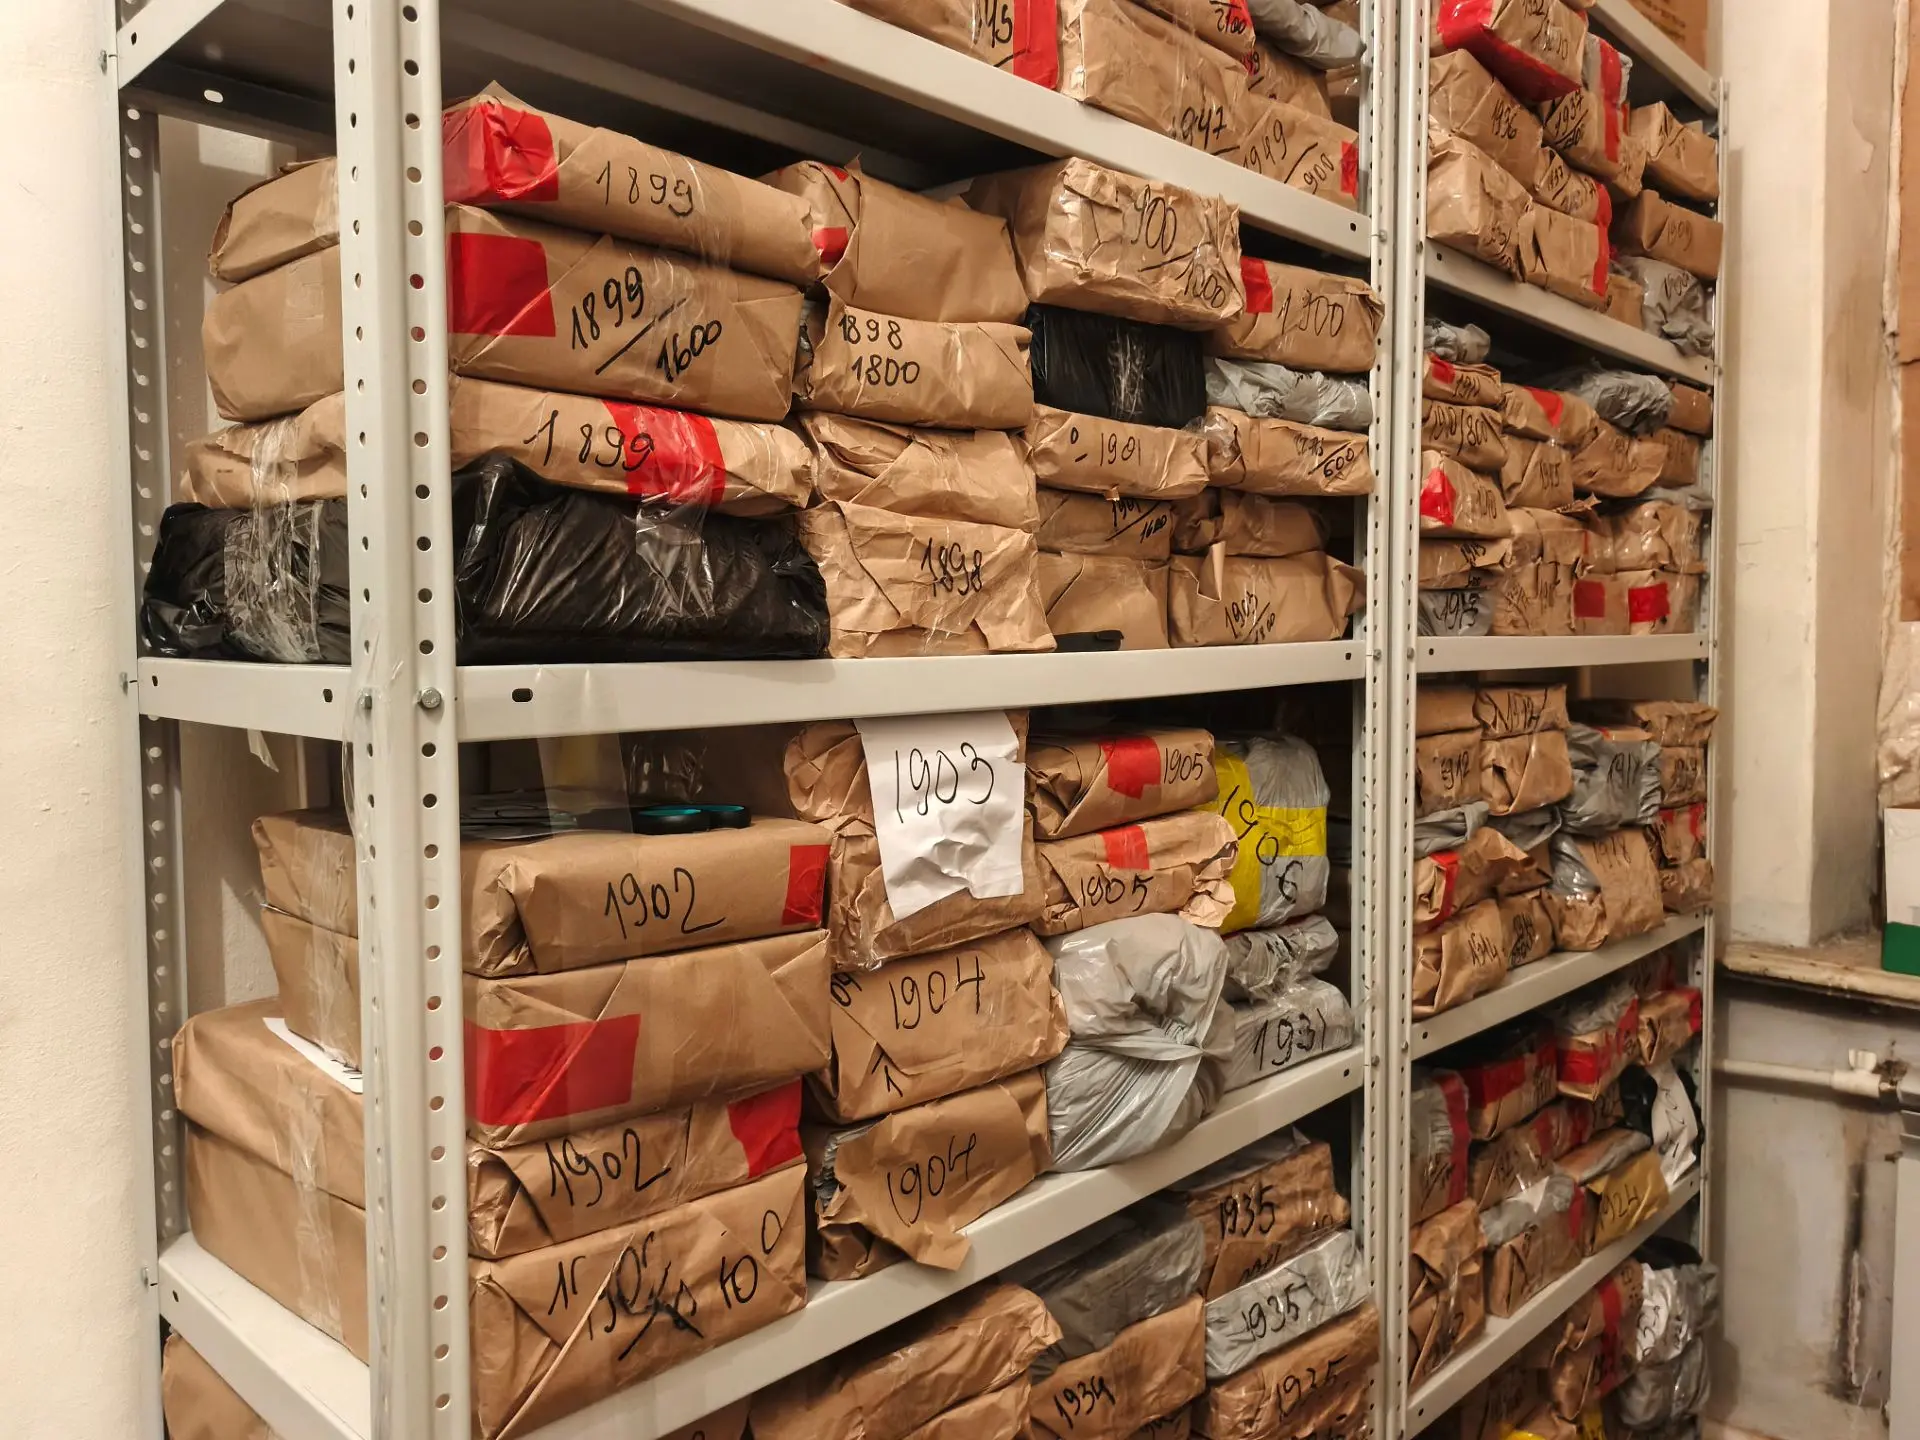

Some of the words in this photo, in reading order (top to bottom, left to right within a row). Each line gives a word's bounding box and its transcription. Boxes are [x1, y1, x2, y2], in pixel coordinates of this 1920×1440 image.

[596, 160, 695, 218] 1899
[1303, 152, 1335, 195] 900
[570, 265, 646, 351] 1899
[837, 313, 905, 348] 1898
[656, 319, 723, 383] 1600
[851, 355, 921, 387] 1800
[523, 410, 657, 473] 1899
[1099, 432, 1142, 467] 1901
[1323, 447, 1355, 478] 600
[919, 537, 984, 597] 1898
[893, 741, 995, 824] 1903
[1164, 746, 1204, 786] 1905
[604, 867, 727, 940] 1902
[1080, 873, 1154, 912] 1905
[888, 956, 986, 1030] 1904
[544, 1128, 672, 1208] 1902
[887, 1133, 977, 1228] 1904
[1219, 1179, 1276, 1240] 1935
[1054, 1375, 1116, 1430] 1934
